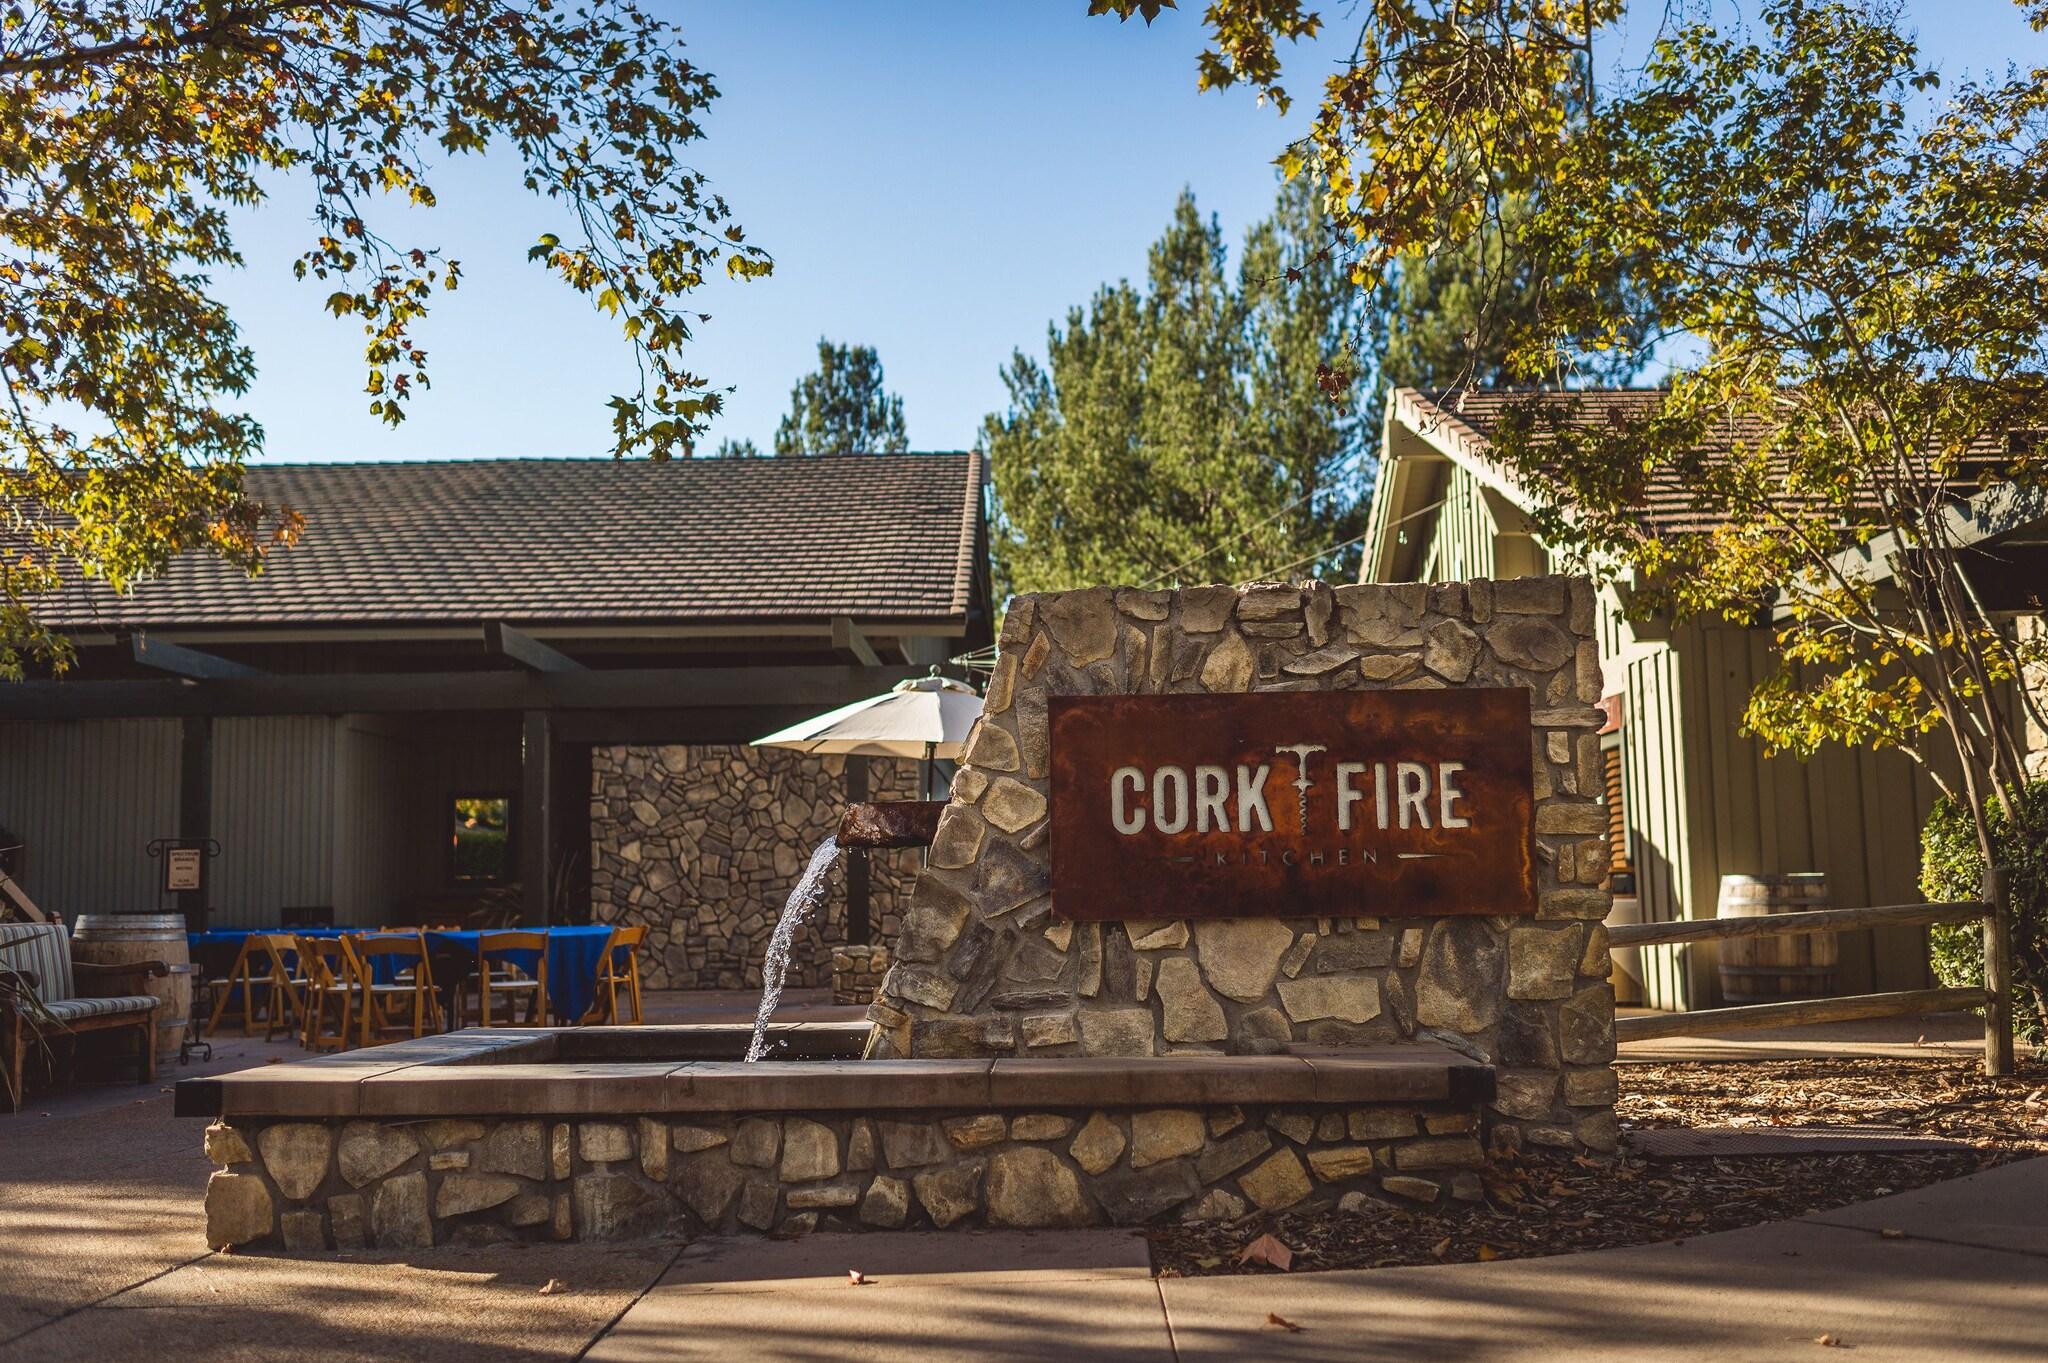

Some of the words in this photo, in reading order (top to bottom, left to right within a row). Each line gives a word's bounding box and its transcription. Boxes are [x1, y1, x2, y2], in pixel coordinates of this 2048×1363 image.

[1111, 764, 1273, 835] CORK
[1336, 762, 1471, 831] FIRE
[1216, 849, 1377, 866] KITCHEN
